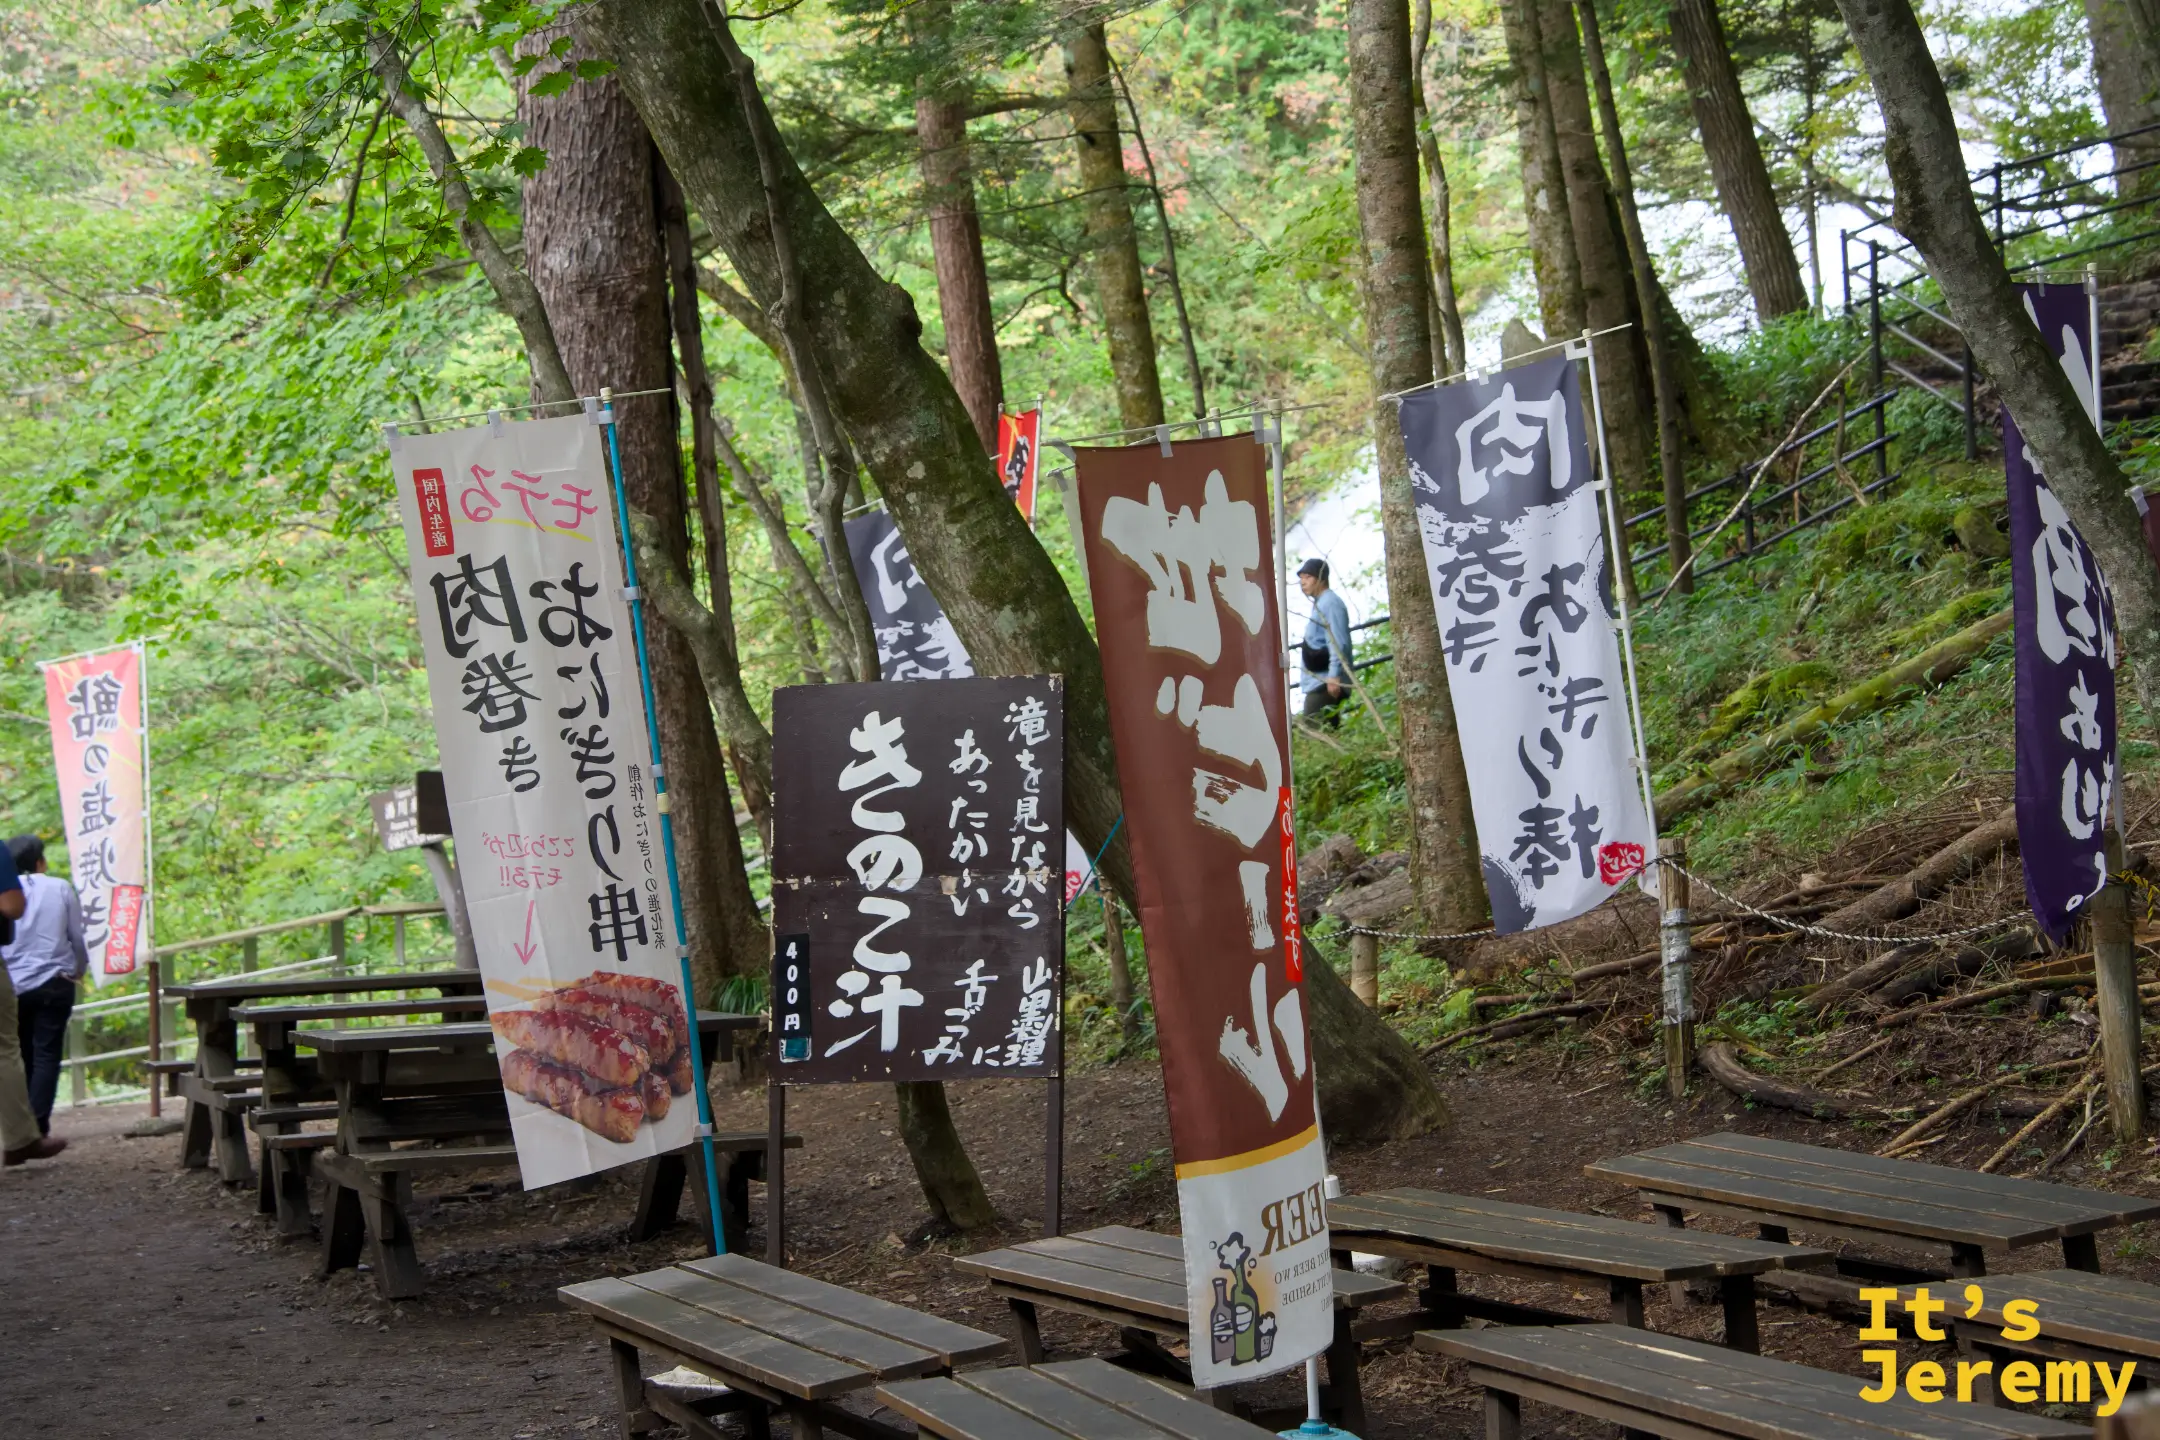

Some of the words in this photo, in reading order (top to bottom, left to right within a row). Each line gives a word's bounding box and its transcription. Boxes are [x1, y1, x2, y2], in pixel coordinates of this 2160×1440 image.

[824, 710, 924, 1057] きのこ汁
[1003, 696, 1051, 929] 滝を見ながら
[784, 941, 800, 1031] 400円
